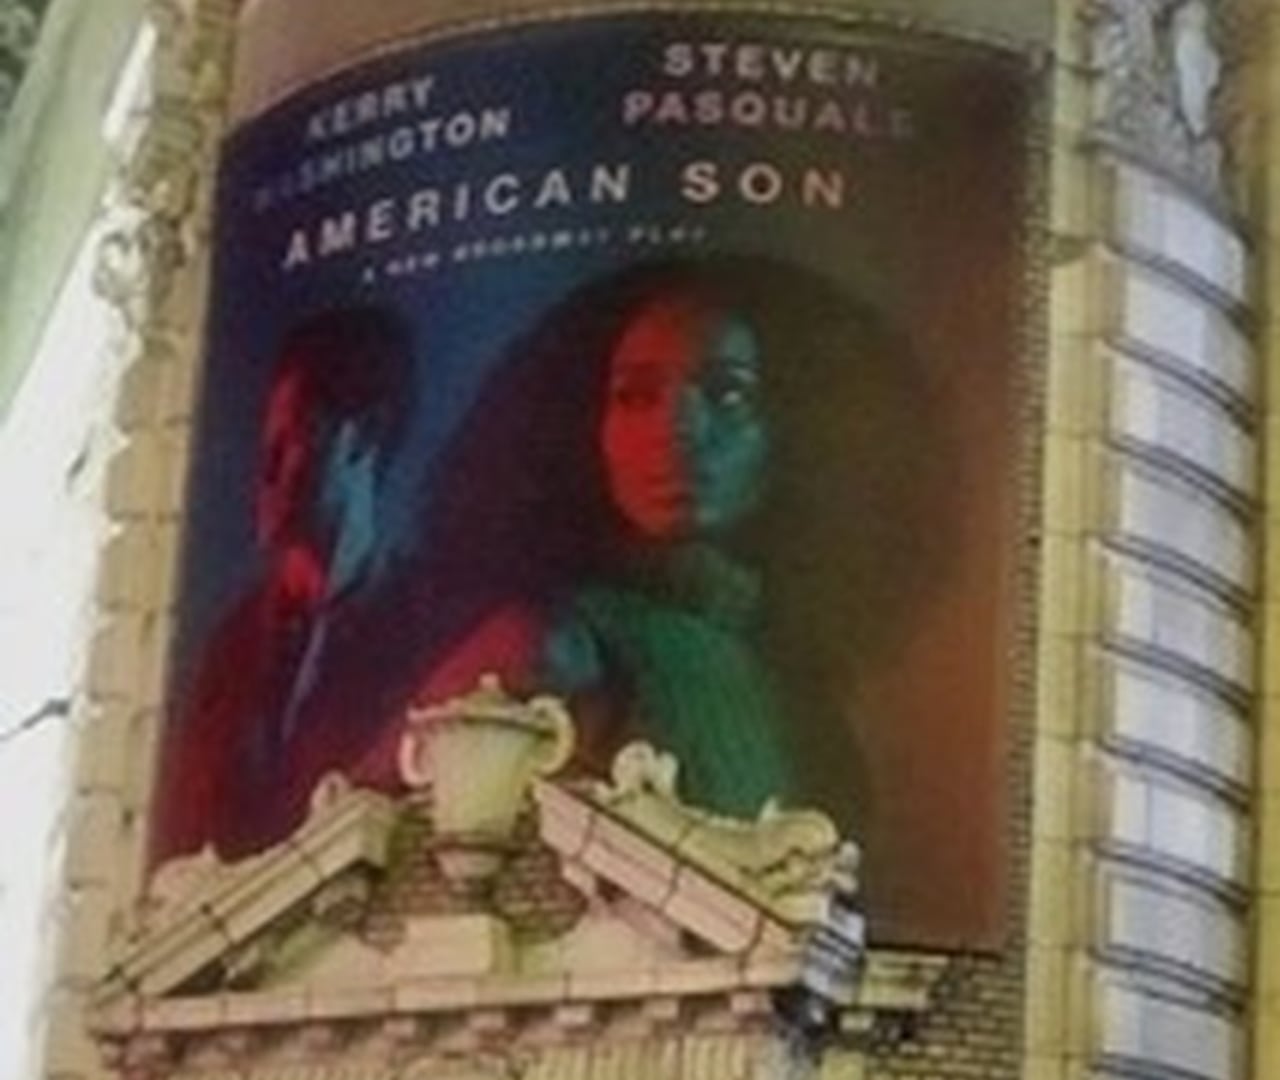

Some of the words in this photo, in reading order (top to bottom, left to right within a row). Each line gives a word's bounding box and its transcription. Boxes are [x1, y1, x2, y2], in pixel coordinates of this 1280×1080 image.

[663, 42, 879, 87] STEVEN
[307, 74, 437, 140] KERRY
[621, 90, 914, 140] PASQUALE
[281, 163, 631, 270] AMERICAN
[680, 162, 845, 208] SON
